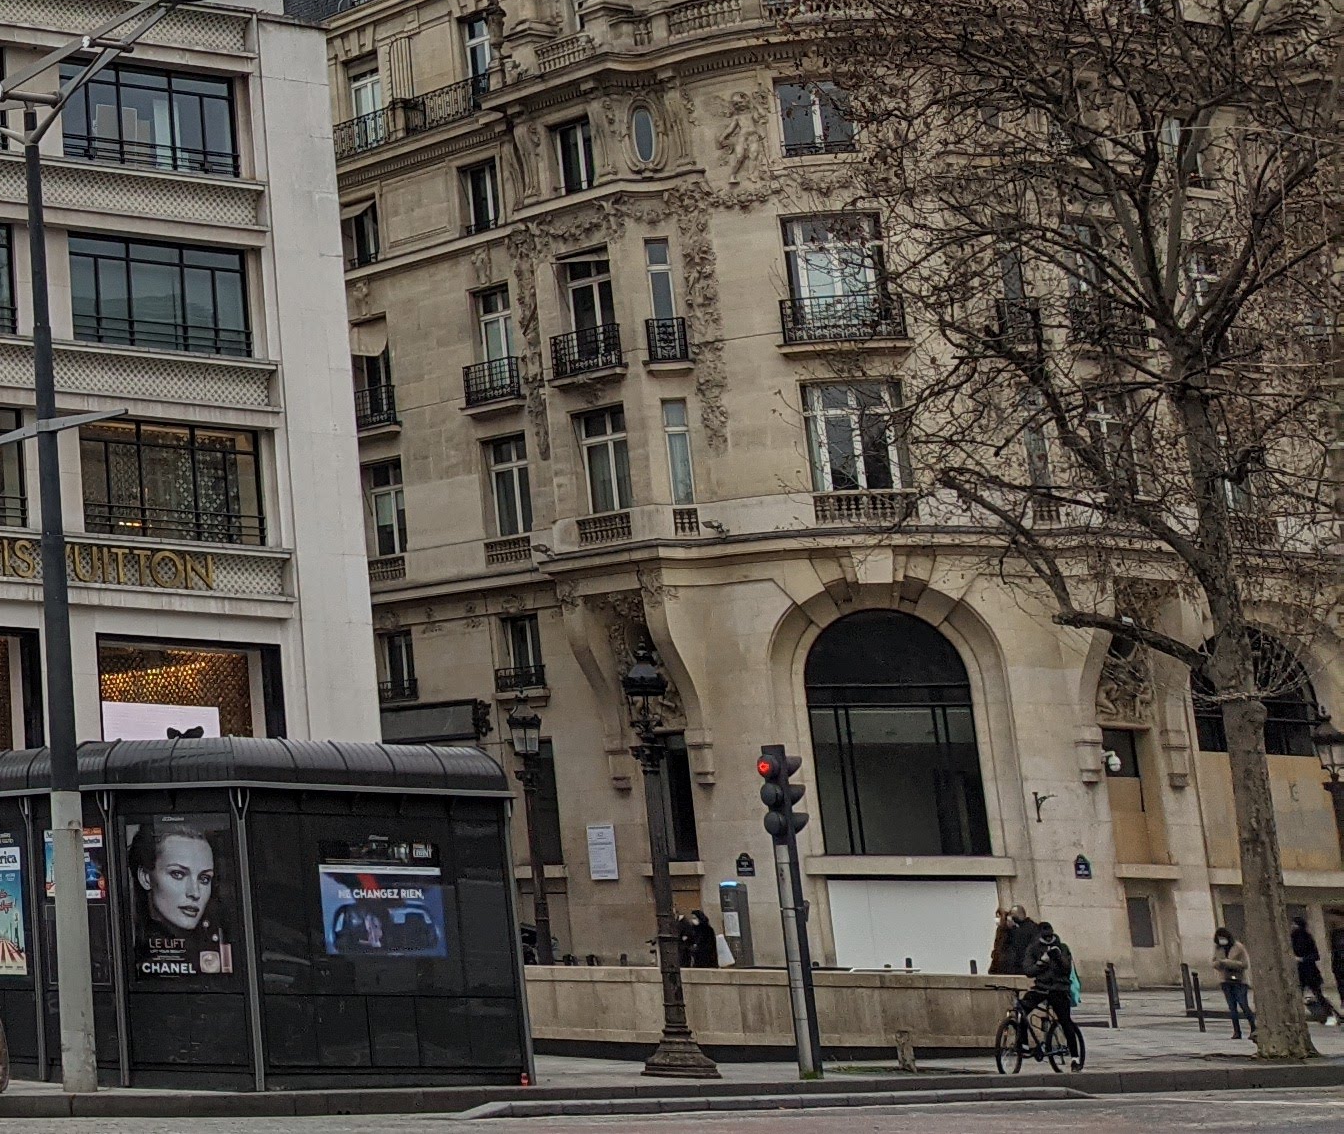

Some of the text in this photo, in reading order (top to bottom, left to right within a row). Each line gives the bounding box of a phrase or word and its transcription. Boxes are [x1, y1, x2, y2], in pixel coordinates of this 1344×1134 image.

[65, 543, 216, 591] UITTON
[353, 889, 400, 899] CHANGEZ
[401, 889, 425, 900] RIEN,
[148, 938, 186, 949] LE LIFT
[141, 962, 197, 974] CHANEL
